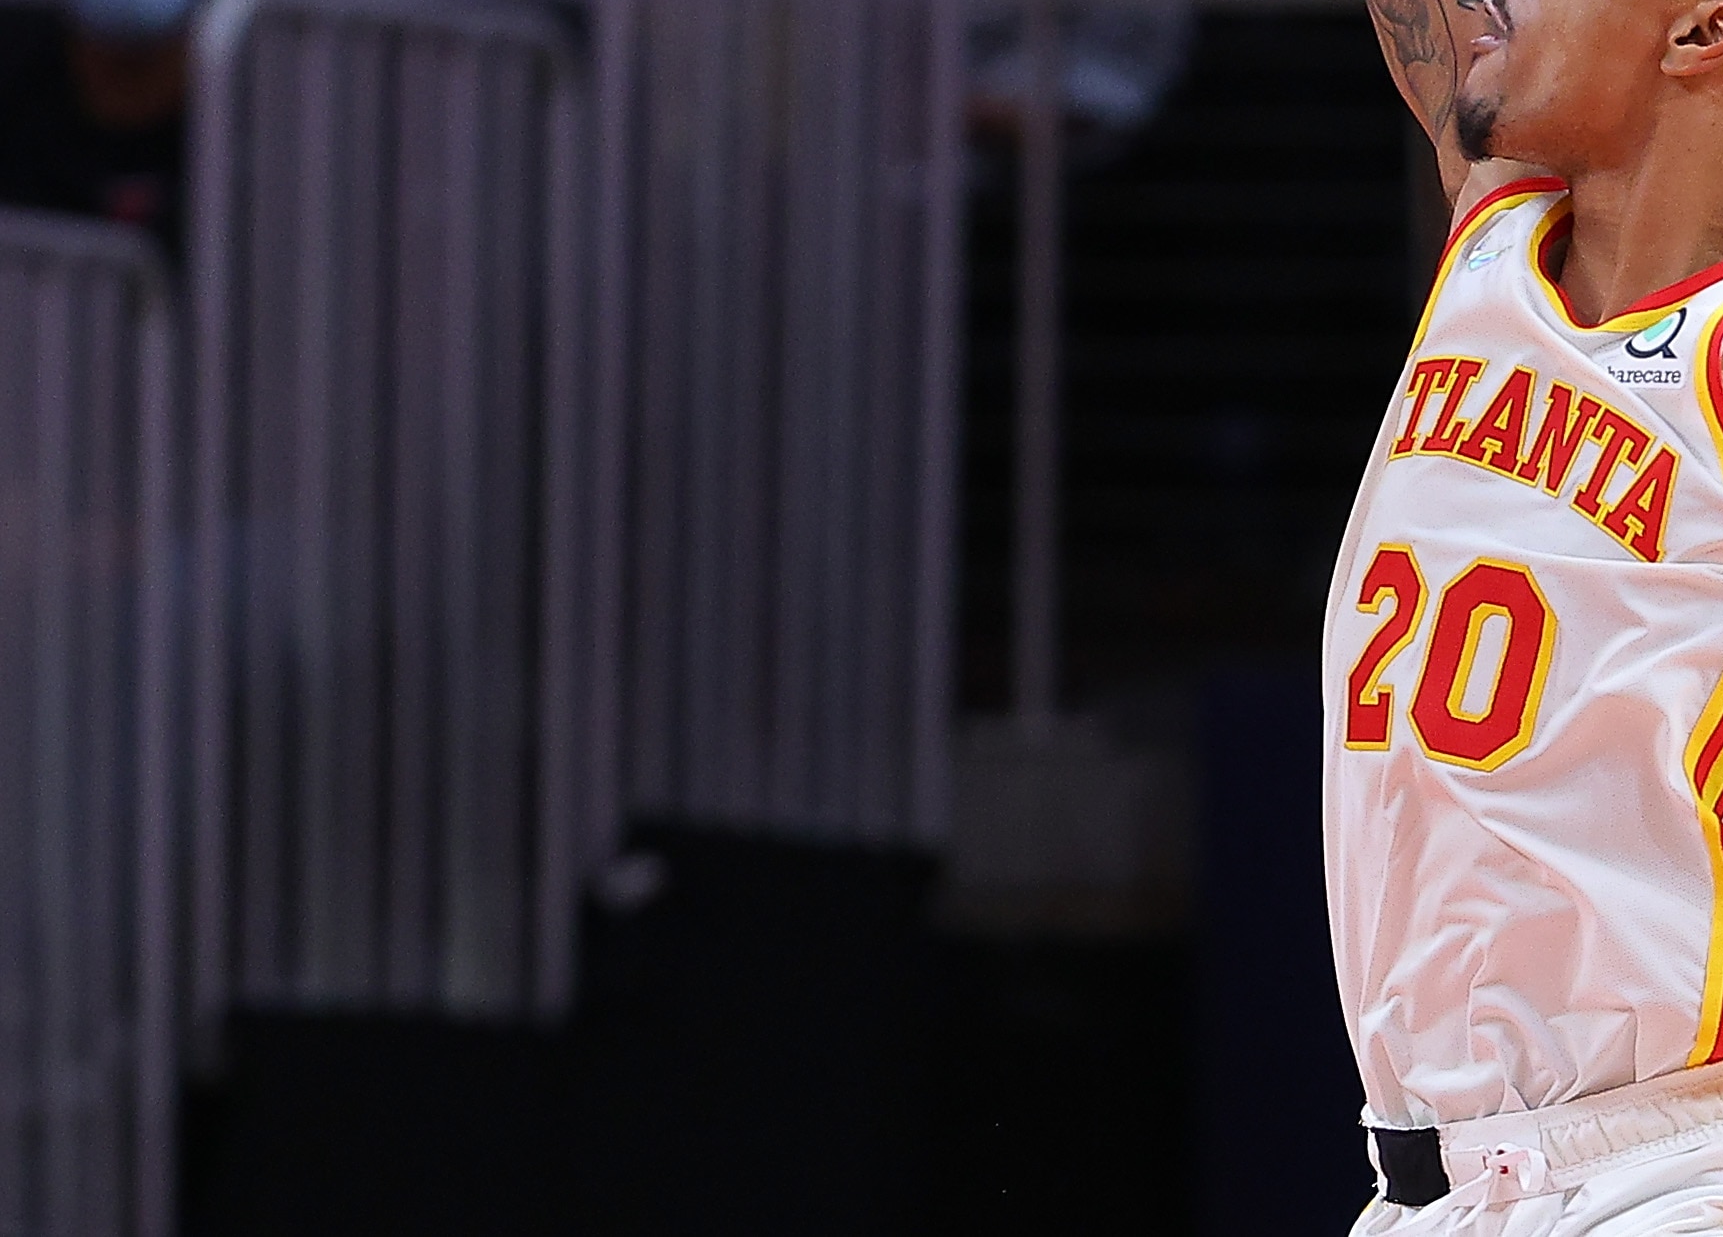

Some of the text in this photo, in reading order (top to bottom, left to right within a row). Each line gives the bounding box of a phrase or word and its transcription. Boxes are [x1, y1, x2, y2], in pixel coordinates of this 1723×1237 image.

[1388, 356, 1681, 563] TLANTA
[1607, 365, 1682, 384] arecare
[1344, 543, 1557, 772] 20
